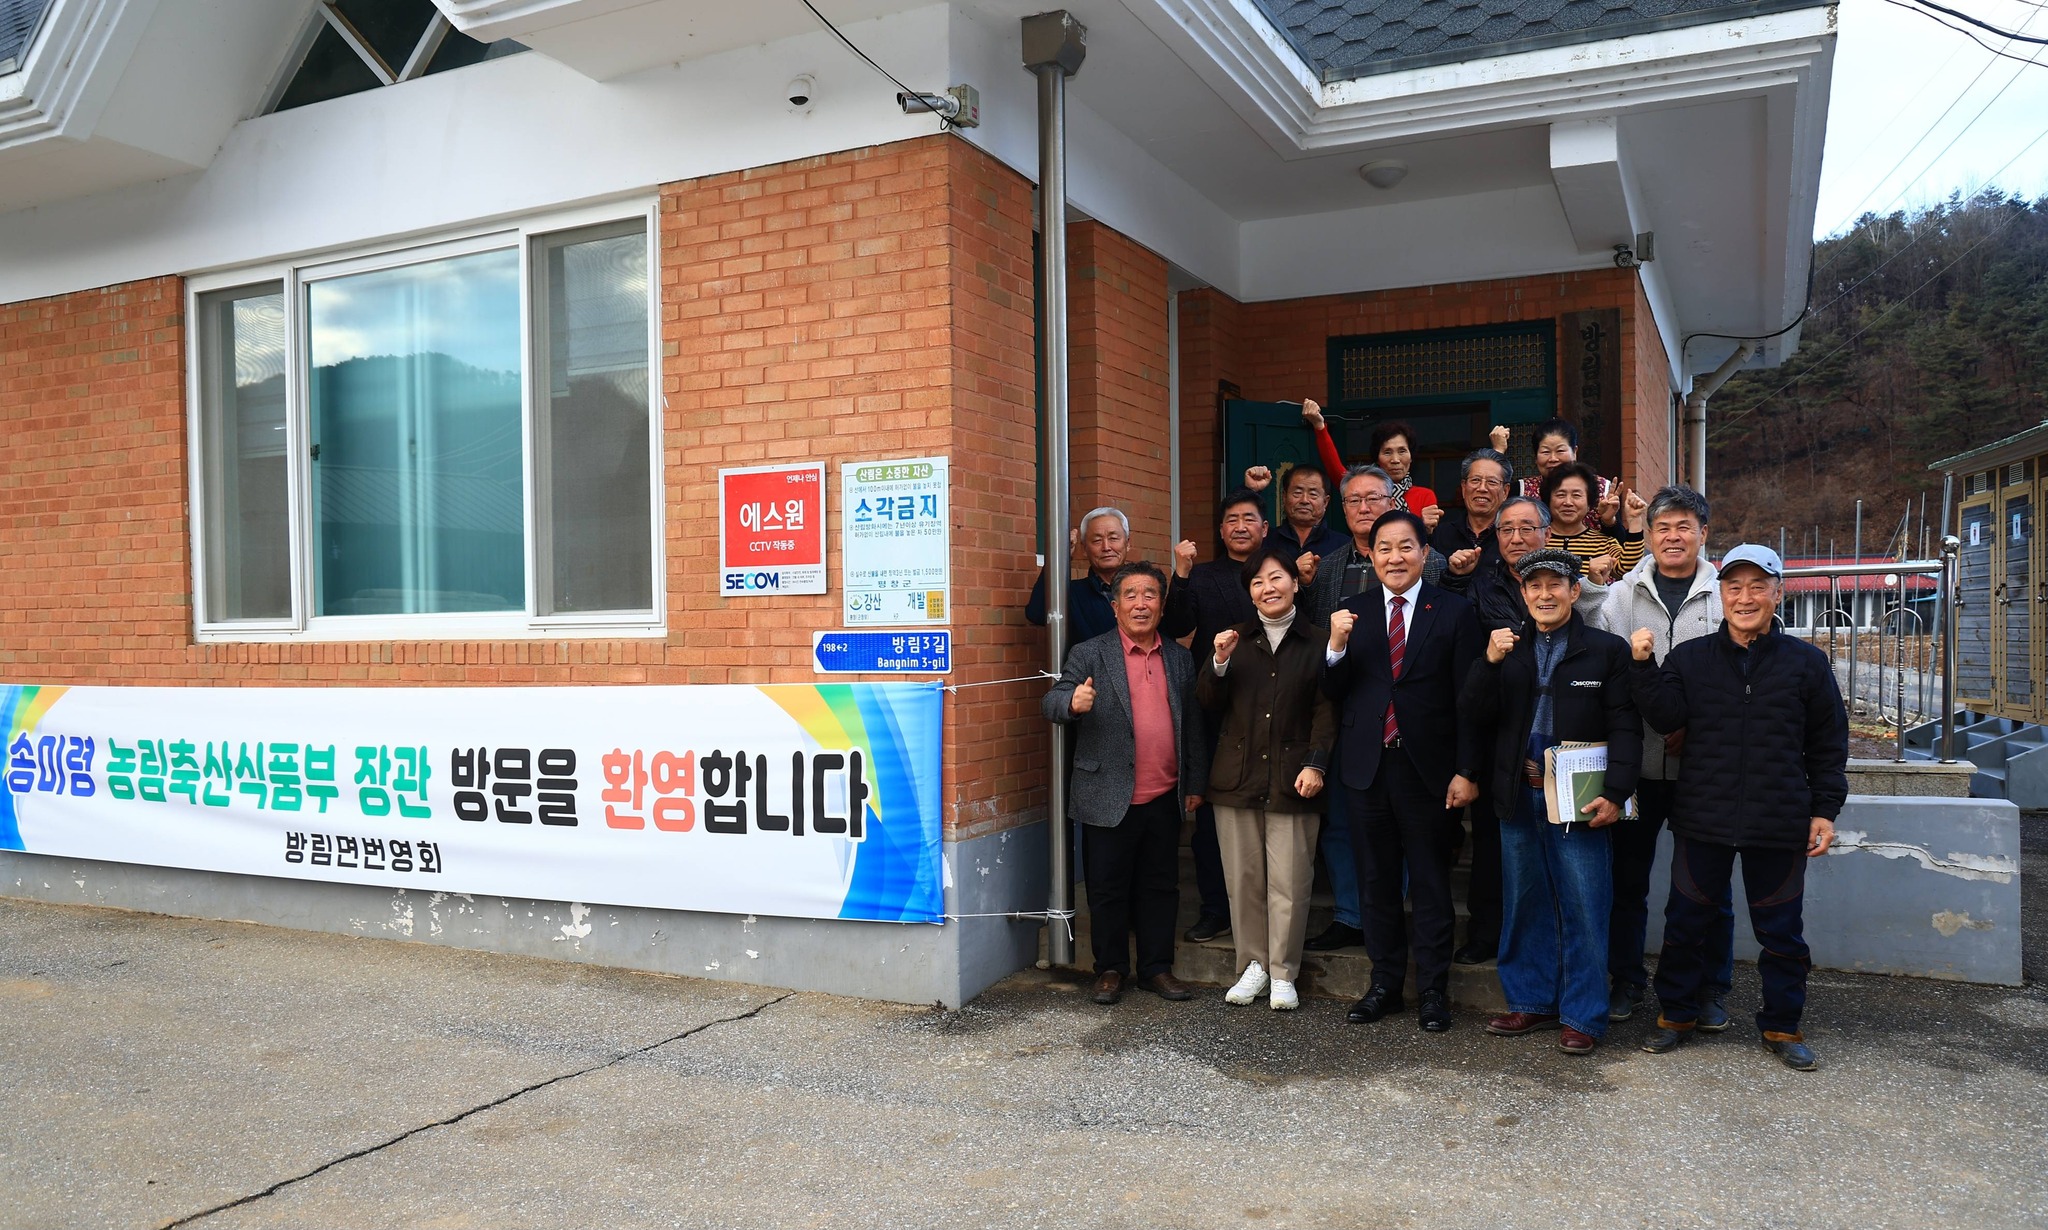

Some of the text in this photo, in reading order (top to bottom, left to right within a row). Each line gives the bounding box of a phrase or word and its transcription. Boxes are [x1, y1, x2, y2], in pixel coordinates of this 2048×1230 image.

[786, 473, 818, 483] 언제나 안심
[859, 465, 928, 481] 산림은 소중한 자산
[739, 499, 805, 532] 에스원
[855, 494, 937, 522] 소각금지
[749, 540, 796, 552] CCTV 작동중
[726, 572, 779, 590] SECOM
[864, 592, 882, 611] 강산
[907, 591, 925, 610] 개발
[822, 643, 836, 652] 198
[892, 636, 945, 654] 방림3길
[877, 657, 945, 669] Bangnim 3-gil
[8, 731, 869, 838] 송미령 농림축산식품부 장관 방문을 환영합니다
[285, 830, 442, 874] 방림면번영회
